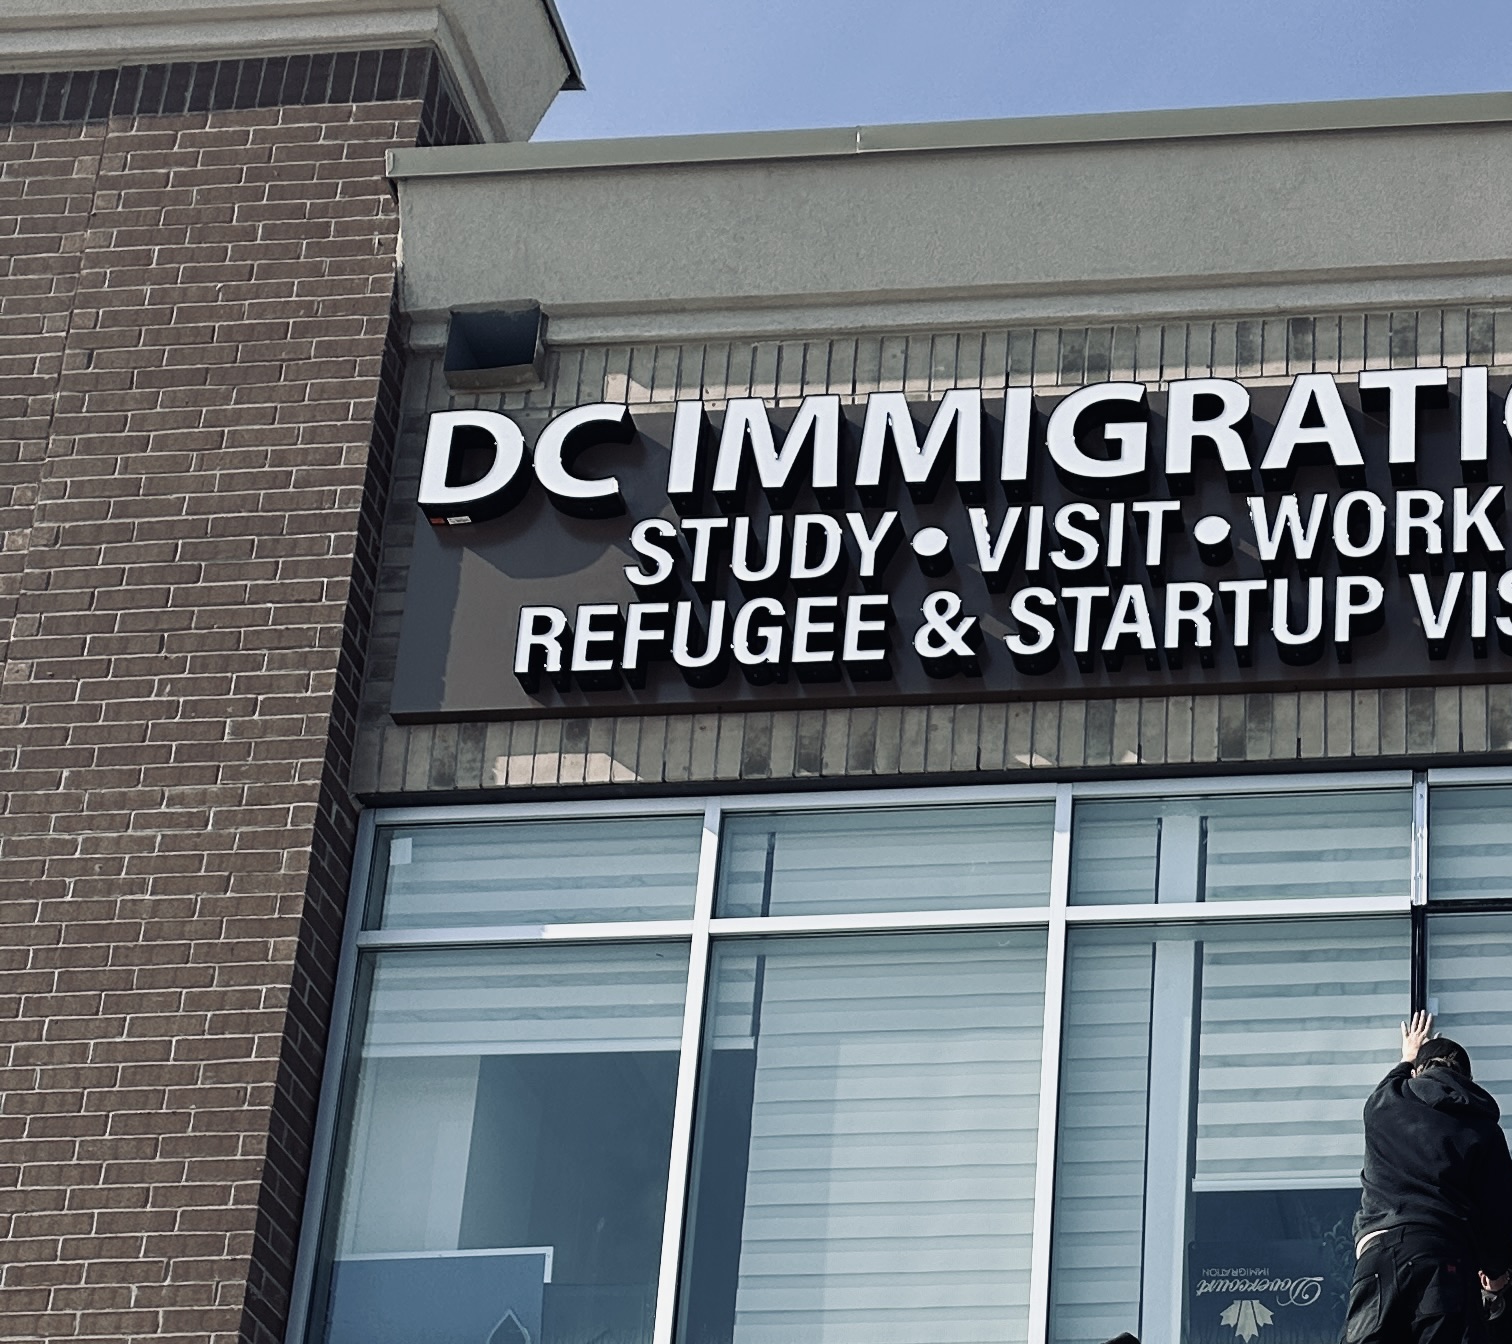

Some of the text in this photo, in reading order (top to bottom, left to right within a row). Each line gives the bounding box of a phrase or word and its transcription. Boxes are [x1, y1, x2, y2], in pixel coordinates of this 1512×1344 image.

[418, 402, 629, 503] DC
[623, 485, 1505, 586] STUDY VISIT WORK
[513, 594, 889, 674] REFUGEE
[914, 590, 977, 658] &
[1004, 575, 1384, 655] STARTUP
[1196, 1277, 1324, 1306] Dovercourt
[1202, 1267, 1270, 1277] IMMIGRATION
